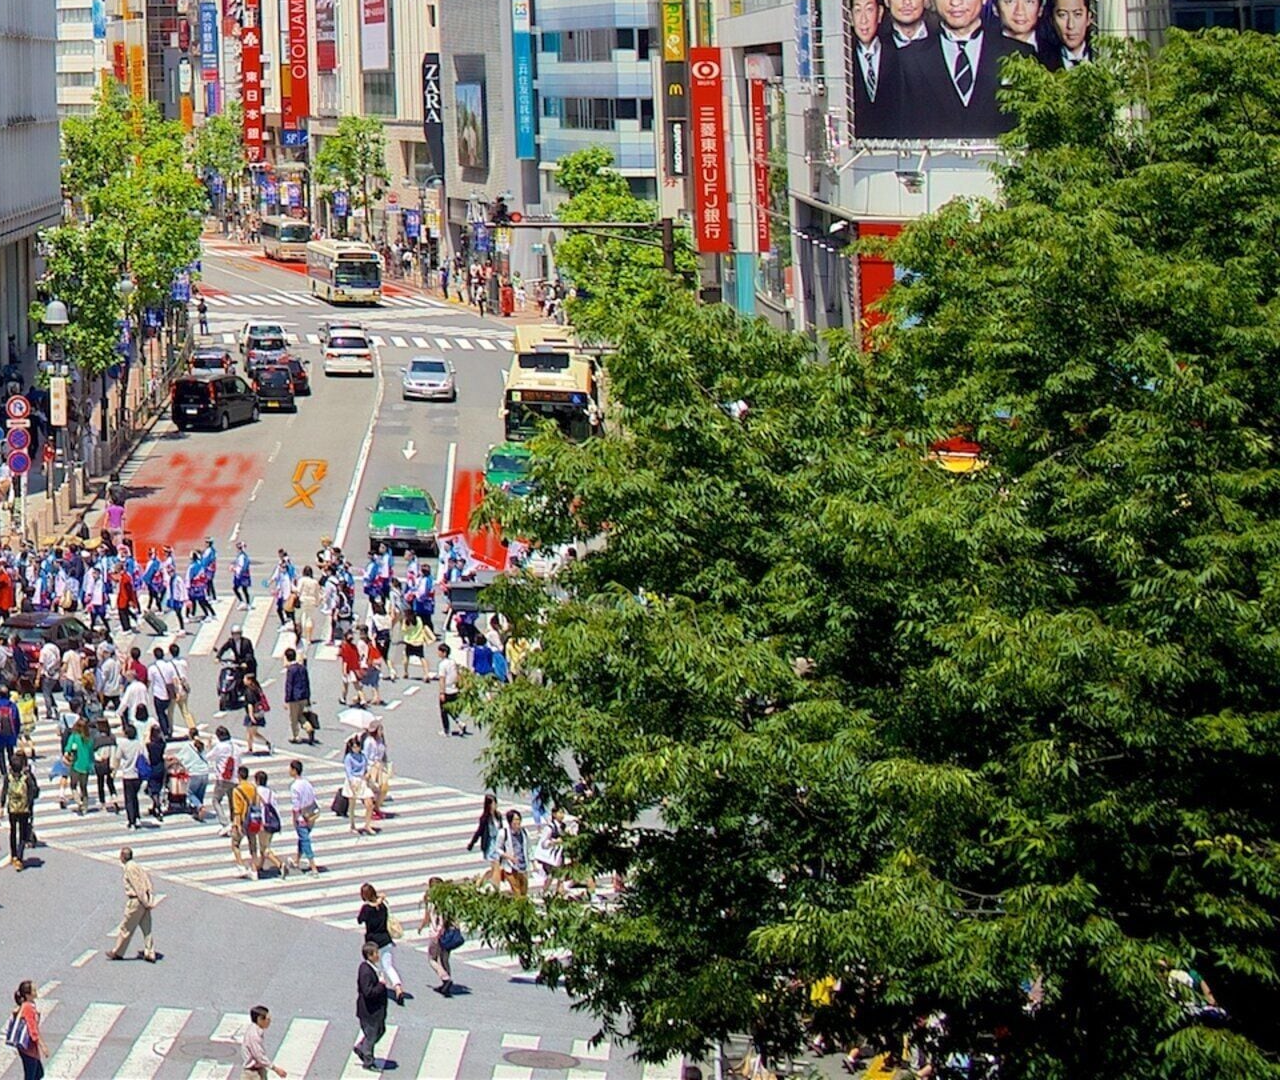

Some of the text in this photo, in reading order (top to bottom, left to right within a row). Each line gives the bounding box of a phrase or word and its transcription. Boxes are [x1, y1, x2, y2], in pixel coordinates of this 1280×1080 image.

[245, 71, 261, 160] 東日本銀行
[425, 65, 440, 123] ZARA
[699, 106, 721, 240] 三菱東京UFJ銀行
